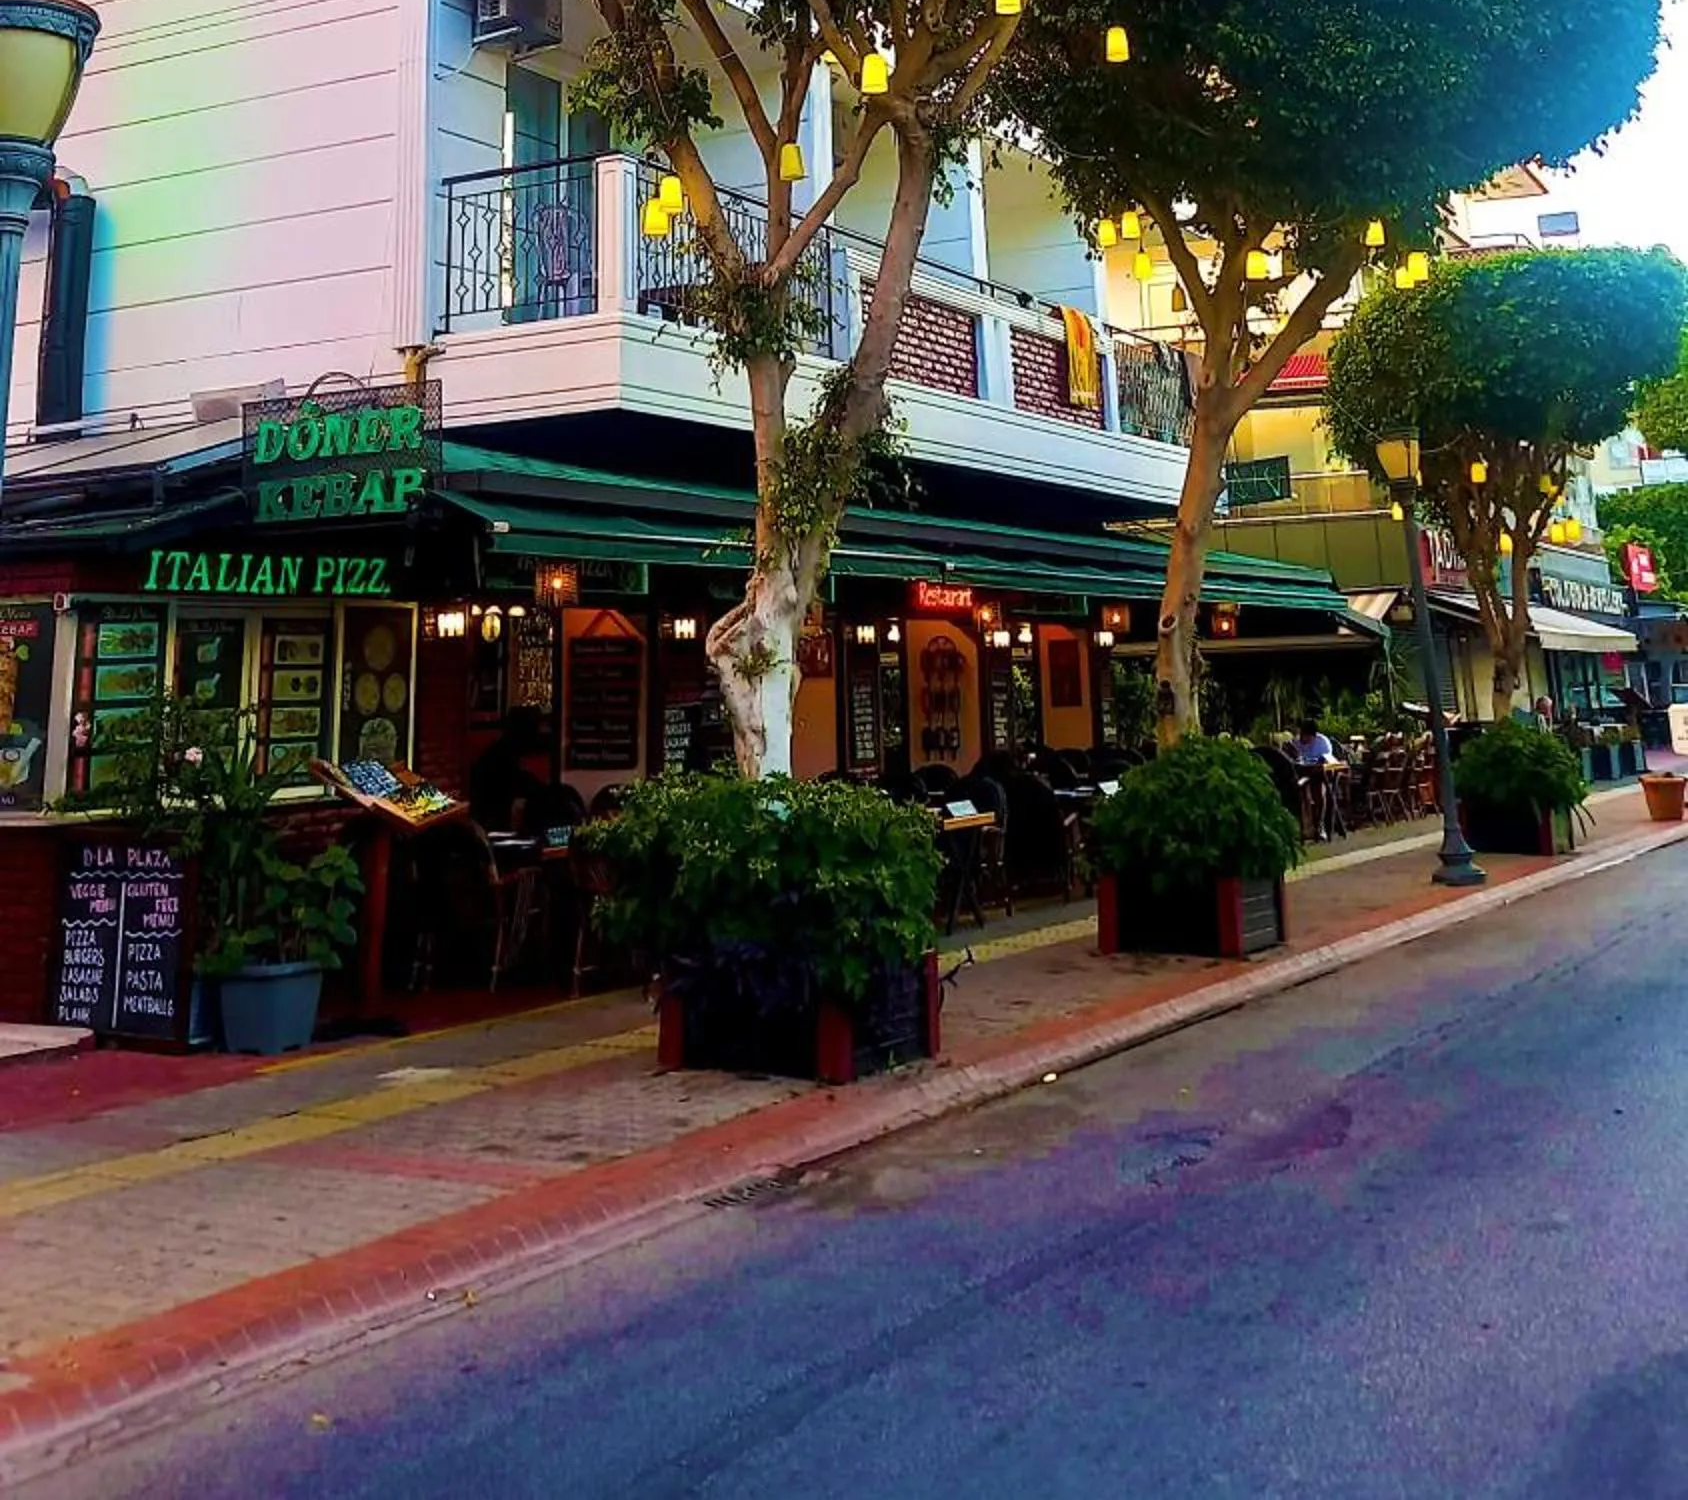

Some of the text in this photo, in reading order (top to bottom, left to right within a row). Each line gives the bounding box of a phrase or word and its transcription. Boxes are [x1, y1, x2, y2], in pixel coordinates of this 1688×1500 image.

[253, 399, 423, 465] DÖNER
[253, 467, 425, 524] KEBAP
[143, 551, 391, 595] ITALIAN PIZZ
[0, 622, 33, 636] EBAP
[127, 848, 171, 868] PLAZA
[69, 883, 107, 900] VEGGIE
[126, 883, 170, 898] GLUTEN
[89, 899, 117, 914] MENU
[155, 898, 179, 913] FREE
[143, 913, 175, 928] MENU
[65, 930, 97, 947] PIZZA
[63, 949, 105, 967] BURGERS
[127, 943, 161, 962] PIZZA
[125, 970, 163, 991] PASTA
[59, 985, 99, 1003] SALADS
[123, 995, 175, 1017] MEATBALLS
